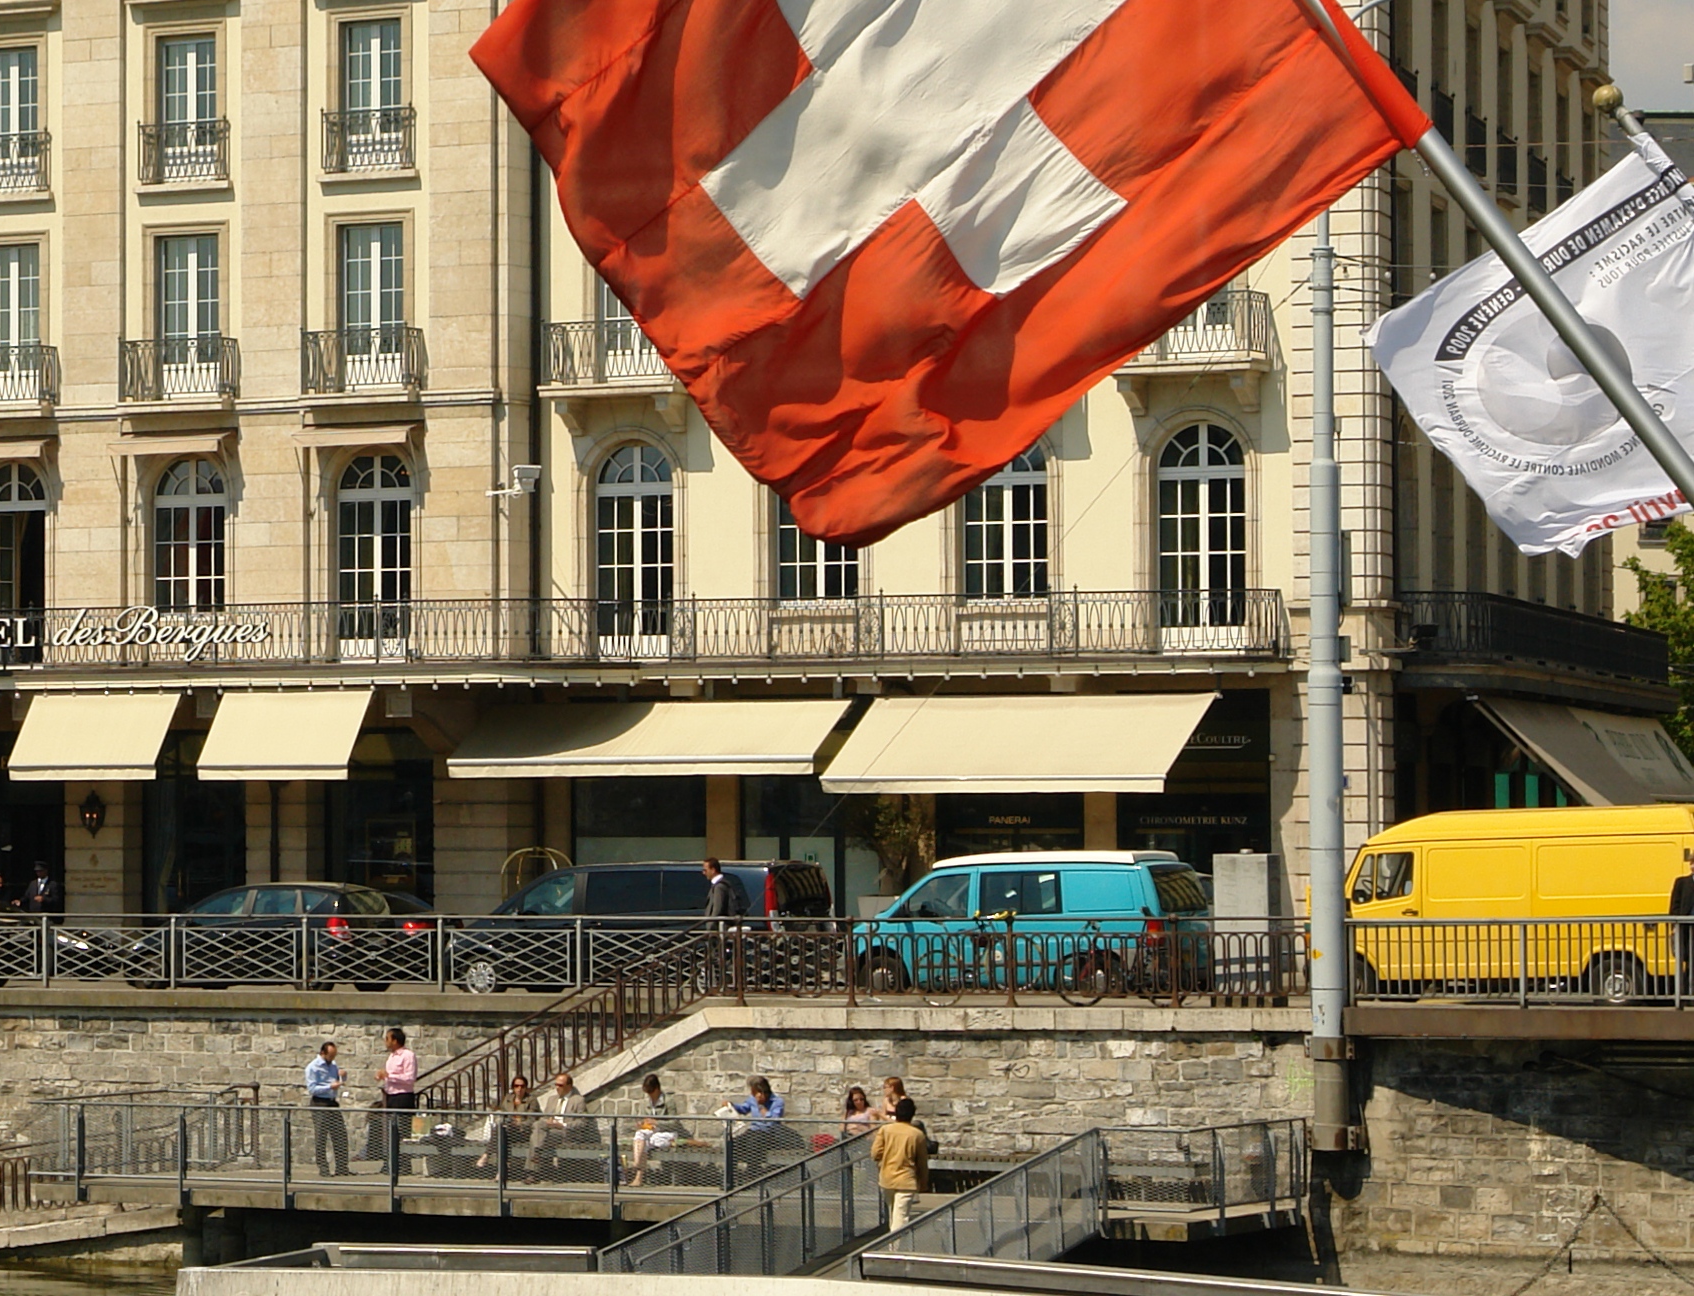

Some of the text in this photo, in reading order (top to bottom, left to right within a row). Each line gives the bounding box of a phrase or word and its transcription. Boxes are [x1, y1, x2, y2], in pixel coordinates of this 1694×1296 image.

[52, 608, 106, 647] des
[109, 605, 270, 663] Bergues
[988, 815, 1031, 825] PANERAI
[1220, 816, 1248, 825] KUNZ
